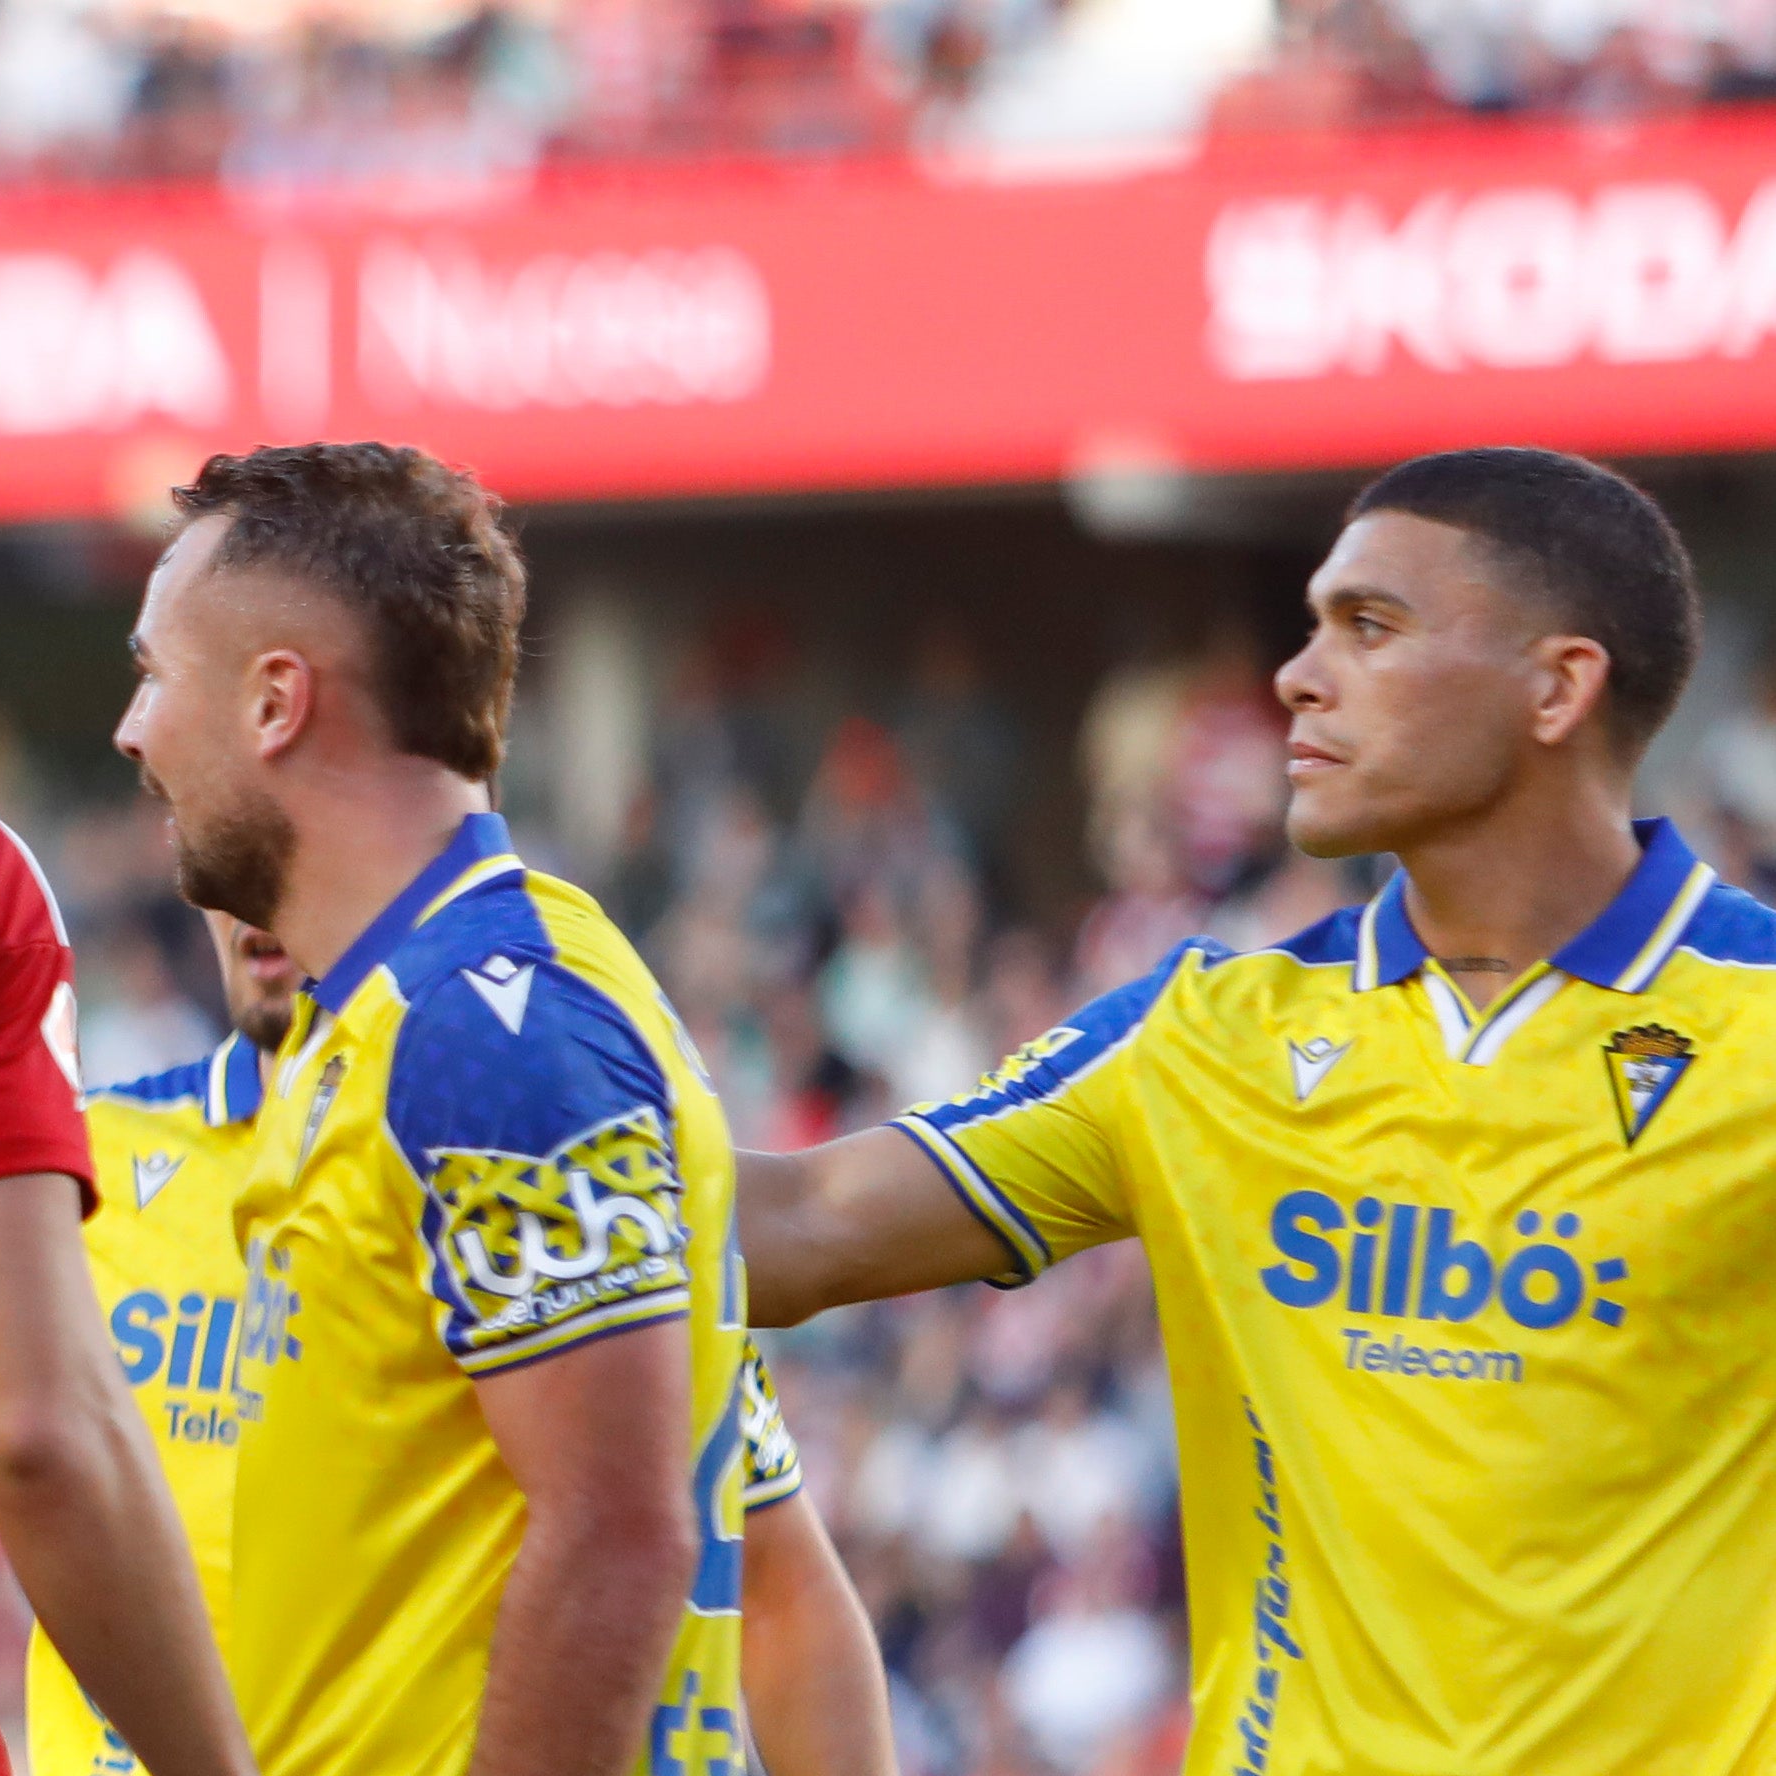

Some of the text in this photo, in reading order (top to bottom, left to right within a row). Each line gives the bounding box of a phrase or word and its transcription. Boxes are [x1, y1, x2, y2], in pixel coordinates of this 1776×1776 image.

[1259, 1190, 1584, 1330] Silbö
[1341, 1328, 1524, 1383] Telecom
[165, 1402, 239, 1446] Tele
